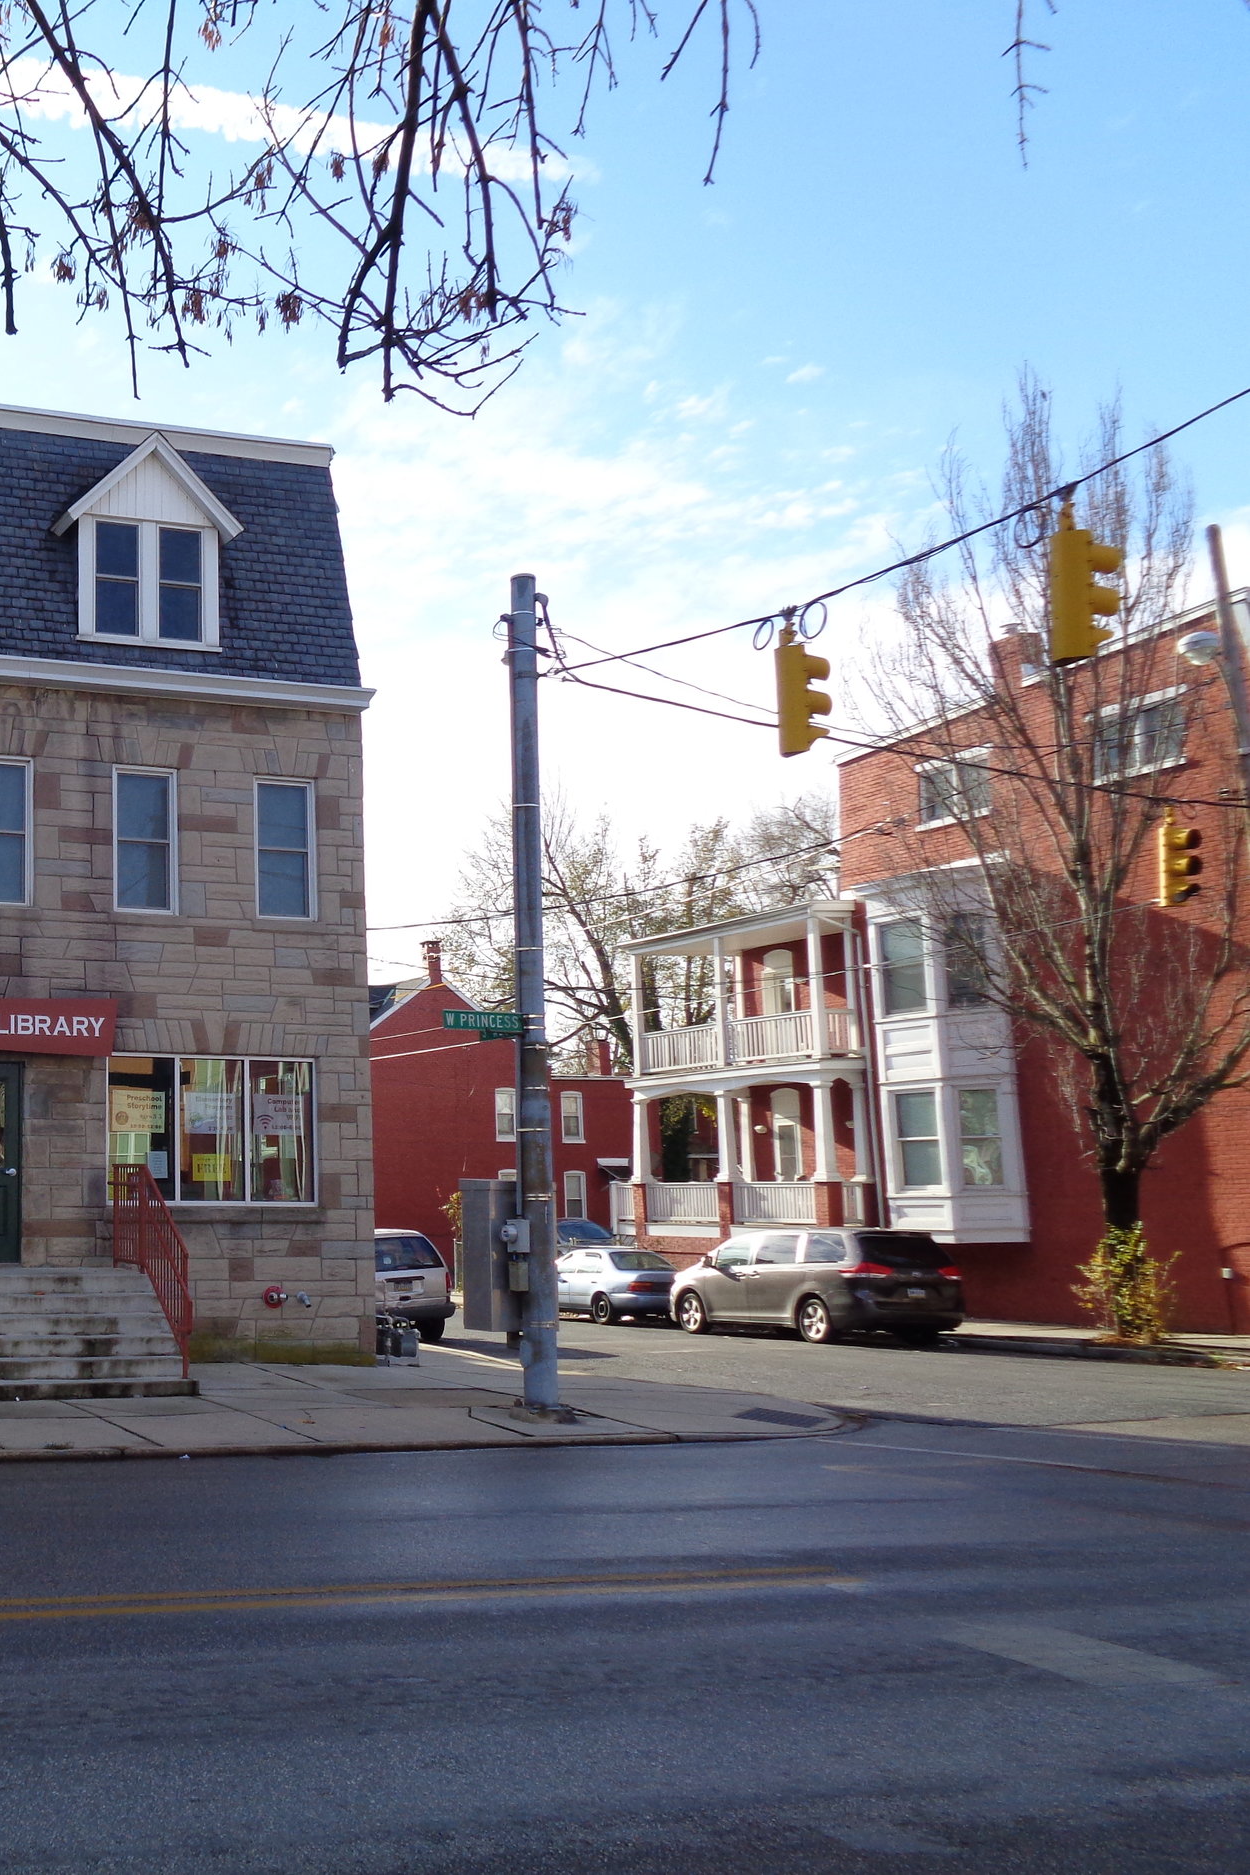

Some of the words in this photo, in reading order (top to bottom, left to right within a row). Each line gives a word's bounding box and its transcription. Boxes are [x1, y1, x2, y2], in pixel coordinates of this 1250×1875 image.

[445, 1013, 454, 1026] W
[460, 1014, 519, 1028] PRINCESS
[127, 1094, 163, 1102] Preschool
[127, 1102, 162, 1111] Storytime
[274, 1105, 287, 1113] Lab
